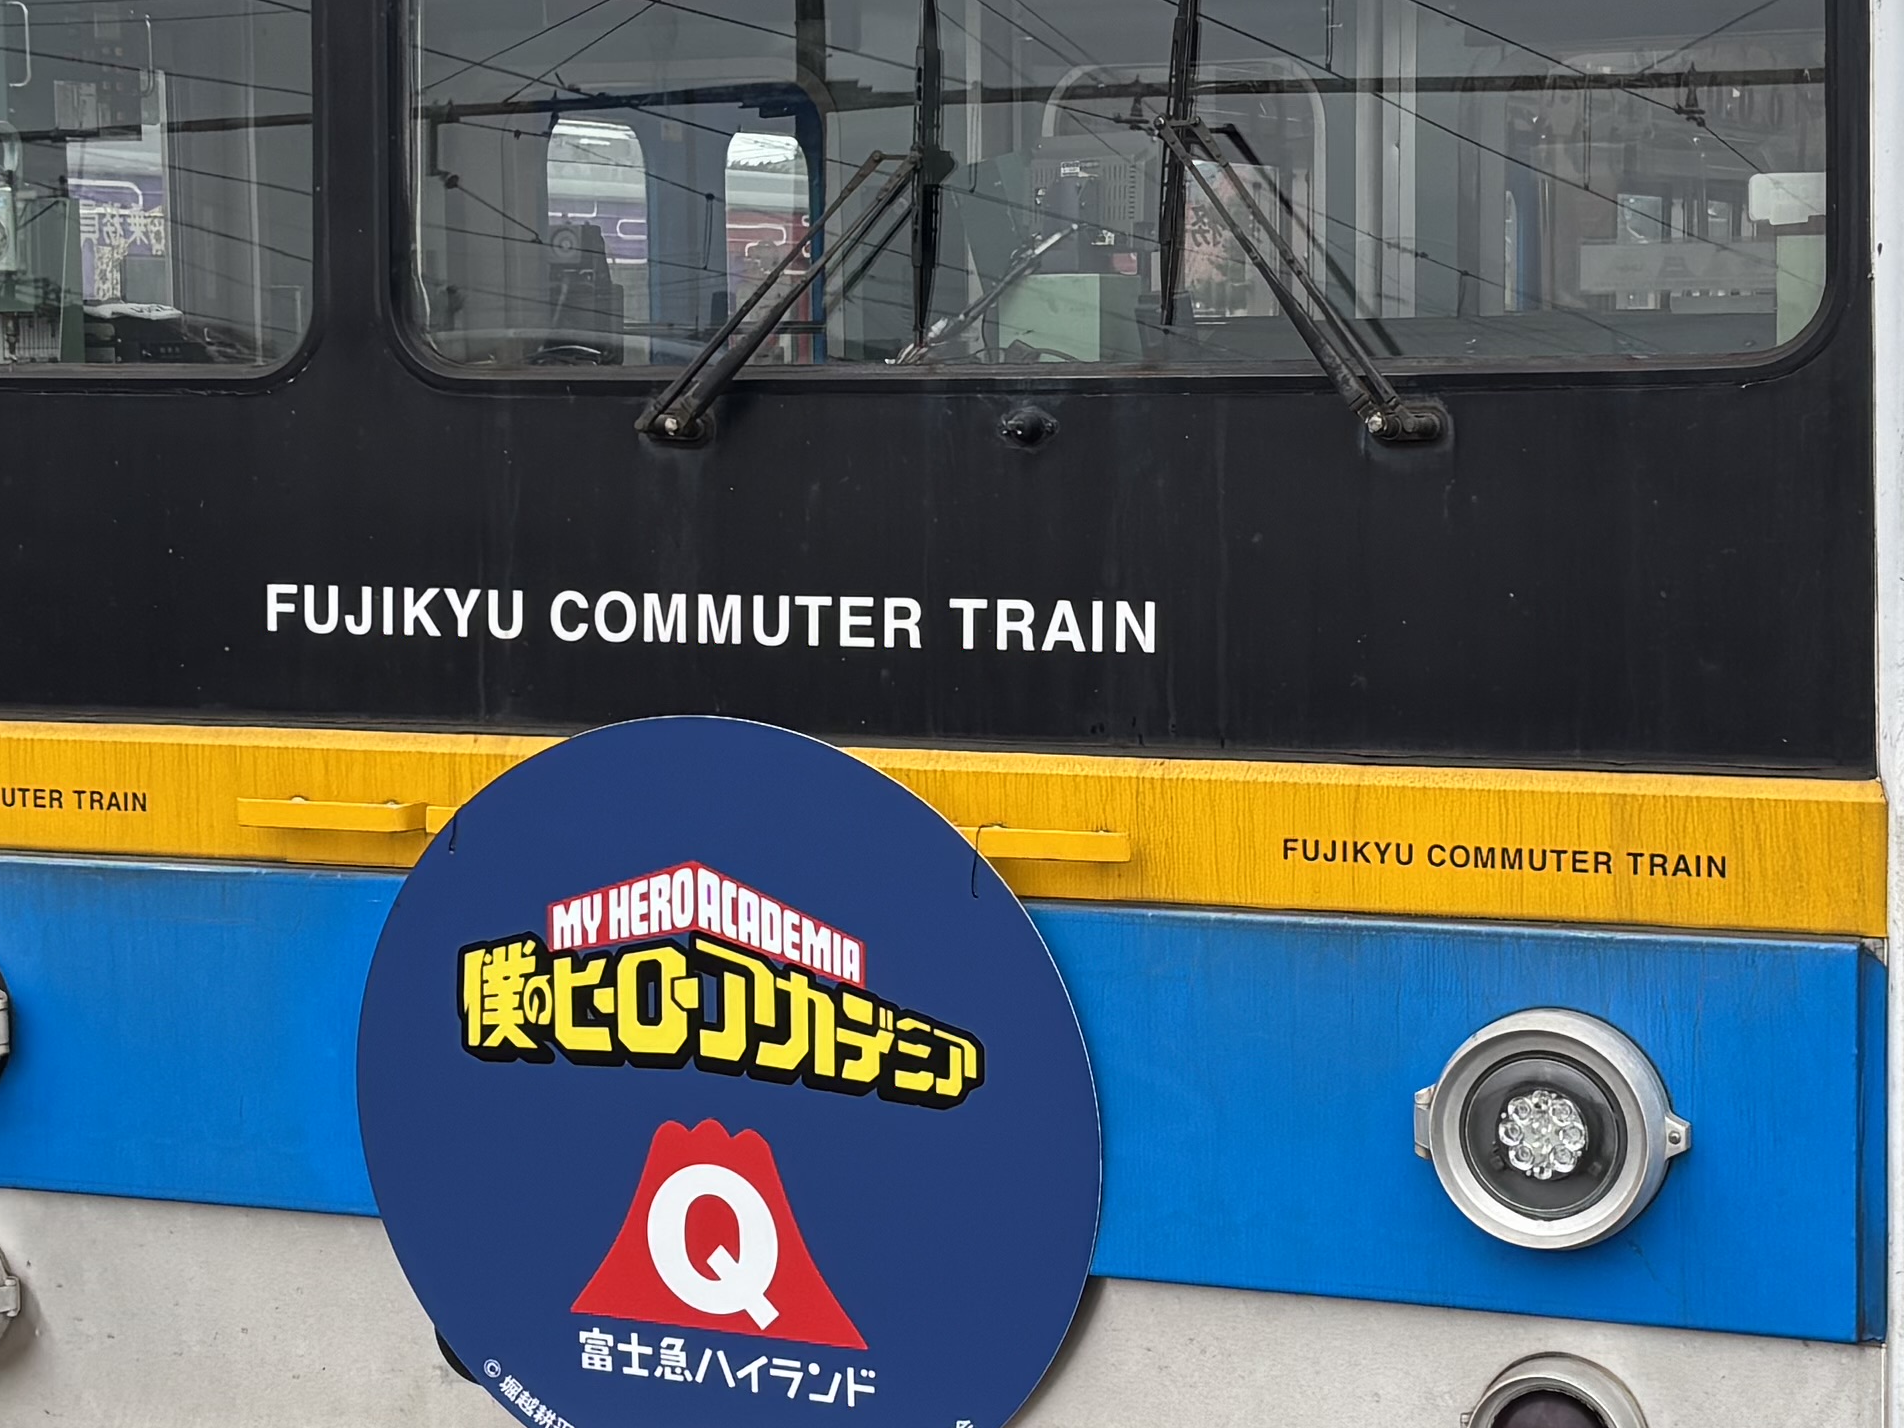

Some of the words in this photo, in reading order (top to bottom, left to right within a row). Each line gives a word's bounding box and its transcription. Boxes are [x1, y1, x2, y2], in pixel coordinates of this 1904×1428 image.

[266, 583, 524, 640] FUJIKYU
[550, 589, 922, 649] COMMUTER
[948, 597, 1156, 654] TRAIN
[72, 790, 148, 812] TRAIN
[1283, 838, 1414, 866] FUJIKYU
[1427, 844, 1612, 875] COMMUTER
[1626, 852, 1727, 879] TRAIN
[552, 902, 602, 950] MY
[608, 867, 694, 940] HERO
[697, 867, 860, 984] ACADEMIA
[463, 940, 977, 1097] 僕のヒーローアカデミア
[647, 1163, 780, 1330] Q
[579, 1327, 876, 1408] 富士急ハイランド
